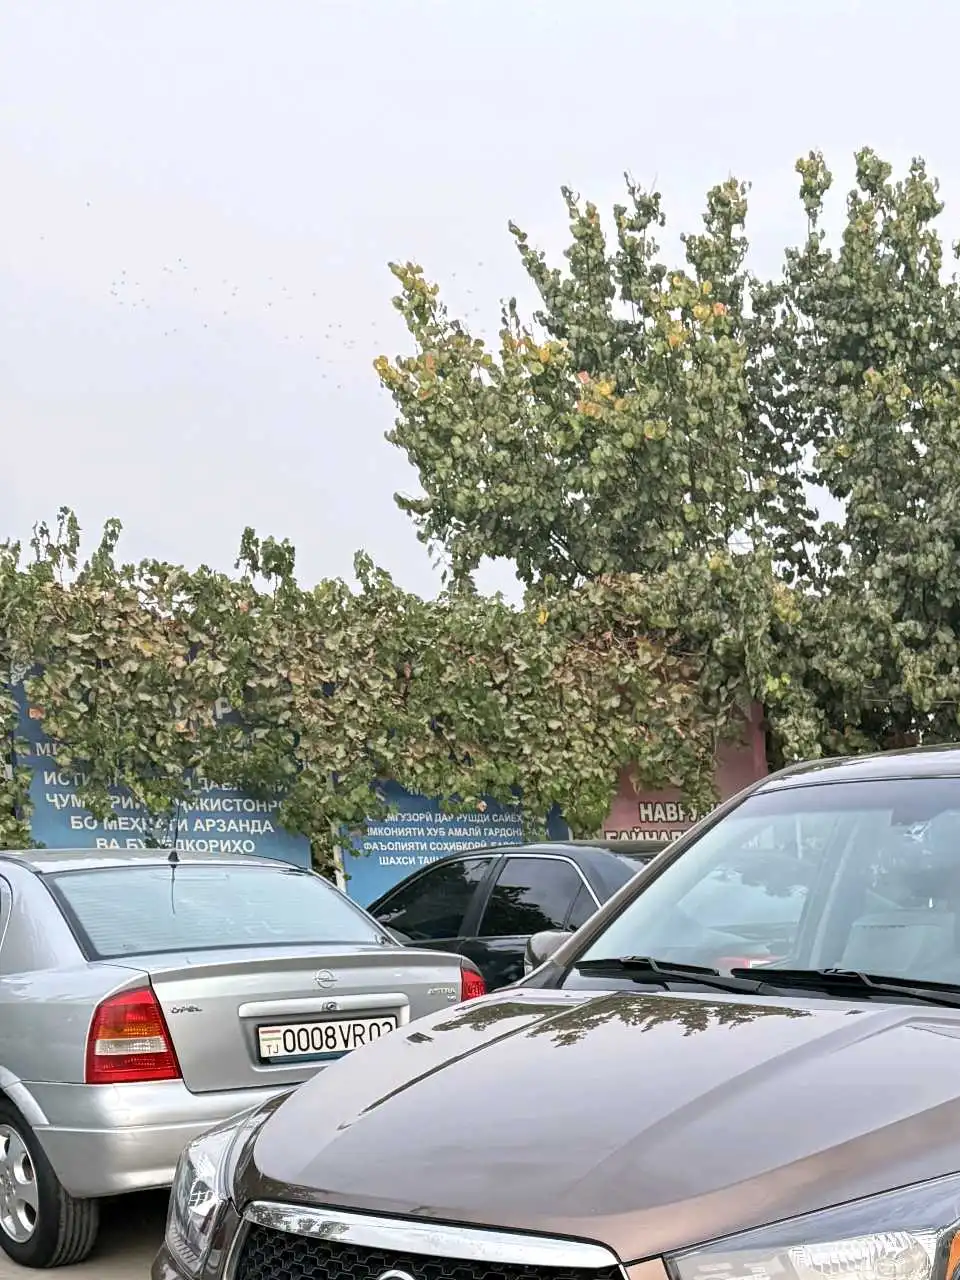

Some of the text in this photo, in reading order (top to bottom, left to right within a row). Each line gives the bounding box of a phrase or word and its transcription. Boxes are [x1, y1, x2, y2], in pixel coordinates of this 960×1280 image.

[194, 818, 275, 835] АРЗАНДА
[379, 856, 416, 865] ШАХСИ
[266, 1044, 279, 1055] TJ
